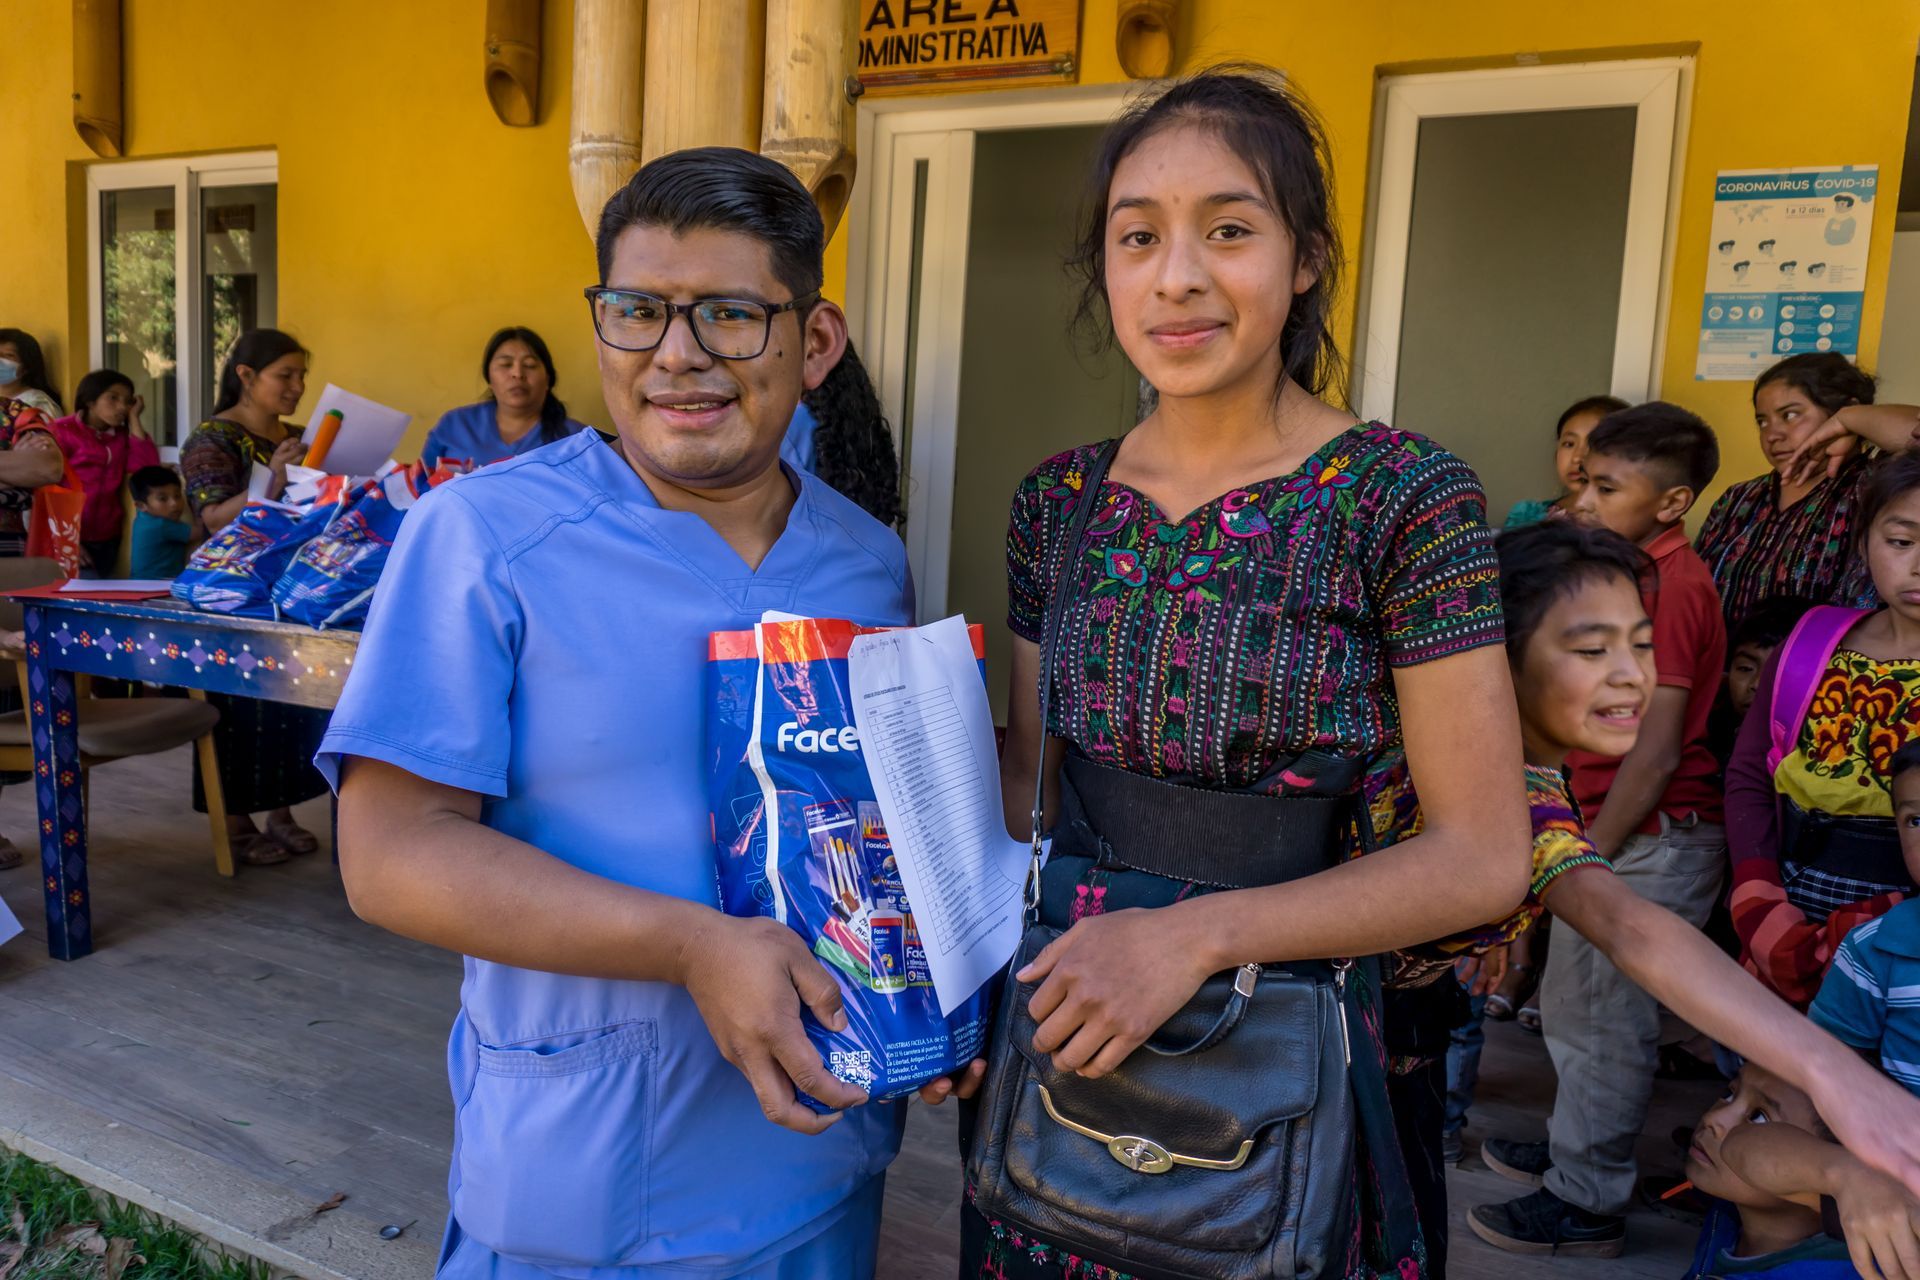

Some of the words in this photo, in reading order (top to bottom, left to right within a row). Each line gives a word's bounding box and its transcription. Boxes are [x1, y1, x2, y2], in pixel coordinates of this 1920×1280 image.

[1718, 180, 1810, 193] CORONAVIRUS
[1815, 177, 1875, 189] COVID-19
[865, 841, 887, 849] Facela
[886, 1041, 911, 1050] INDUSTRIAS
[903, 1048, 921, 1056] carretera
[910, 1055, 925, 1063] Antiguo
[887, 1076, 898, 1084] Casa
[898, 1074, 912, 1082] Matriz
